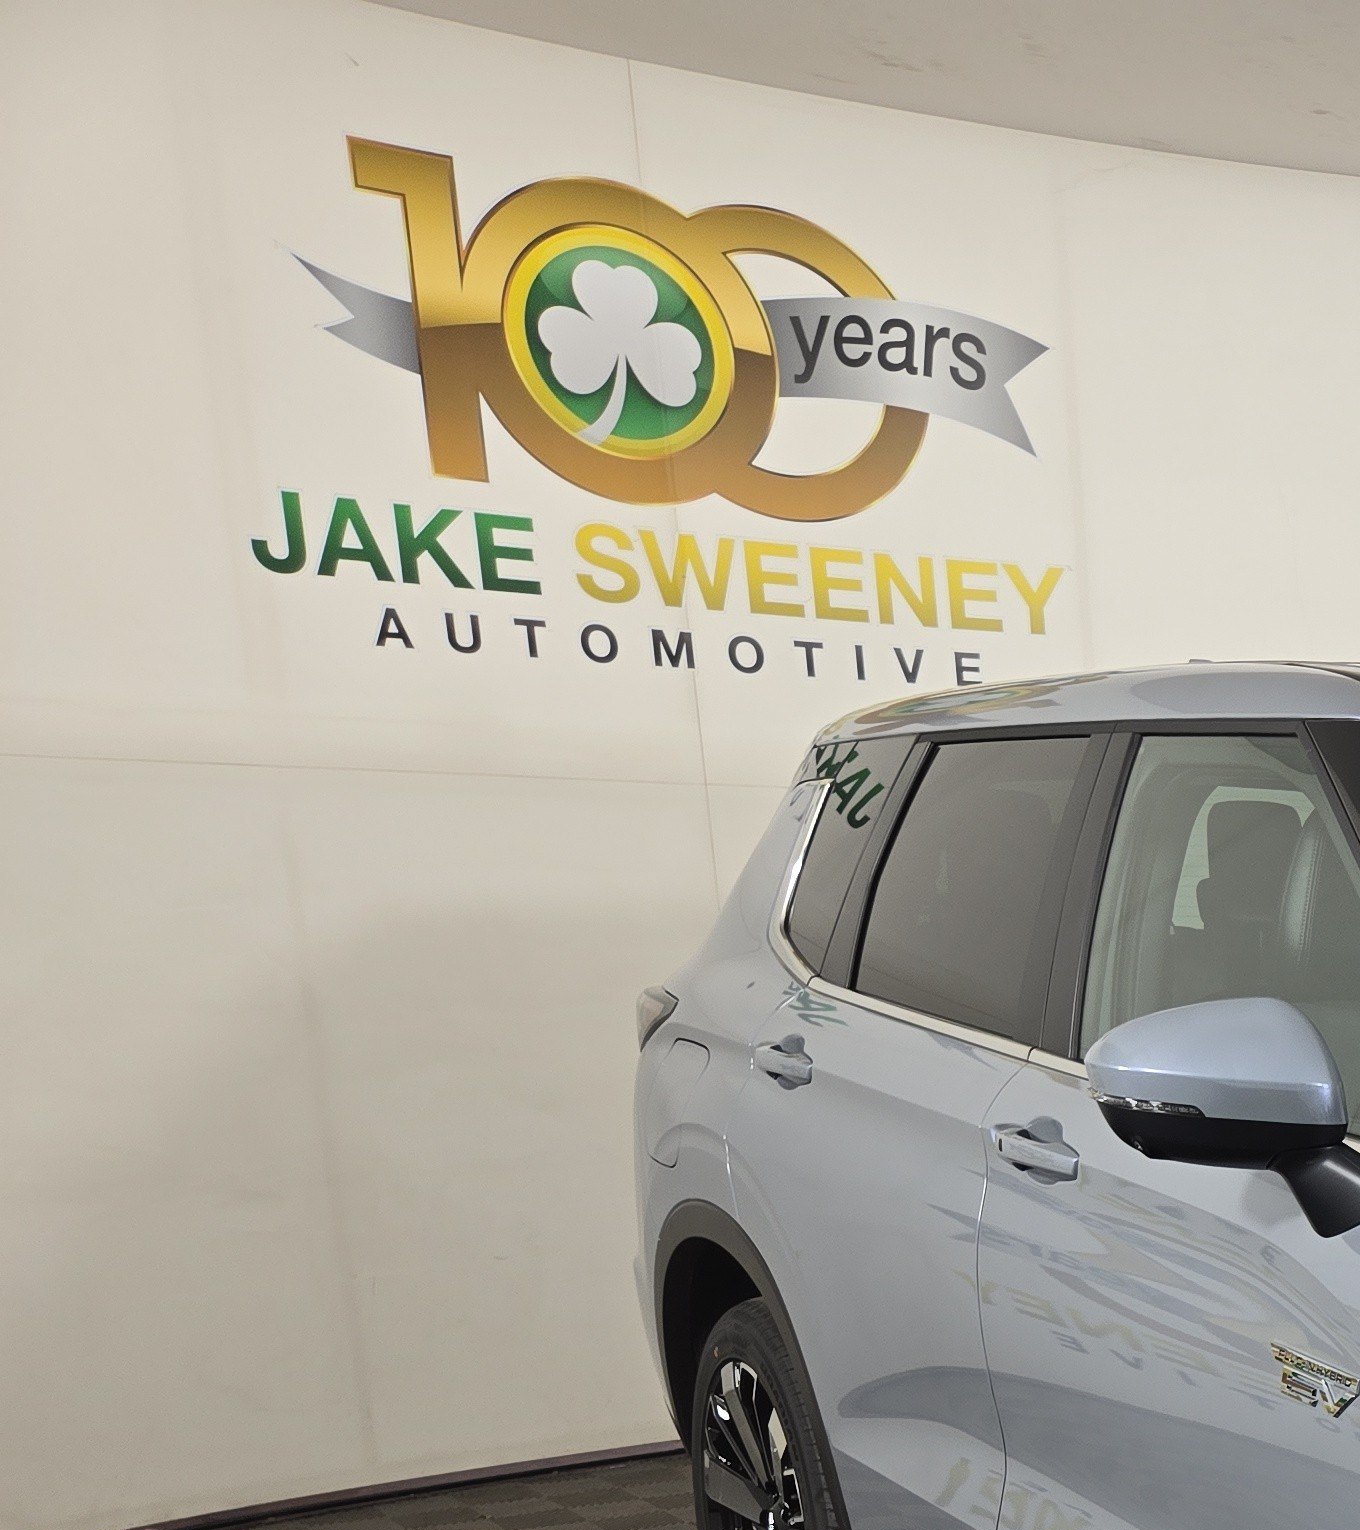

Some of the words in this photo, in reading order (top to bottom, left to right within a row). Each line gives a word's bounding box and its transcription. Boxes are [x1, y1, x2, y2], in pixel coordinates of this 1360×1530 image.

[346, 135, 930, 522] 100
[788, 313, 988, 392] years
[250, 490, 542, 596] JAKE
[574, 522, 1065, 636] SWEENEY
[375, 607, 984, 686] AUTOMOTIVE
[1281, 1366, 1360, 1419] EV
